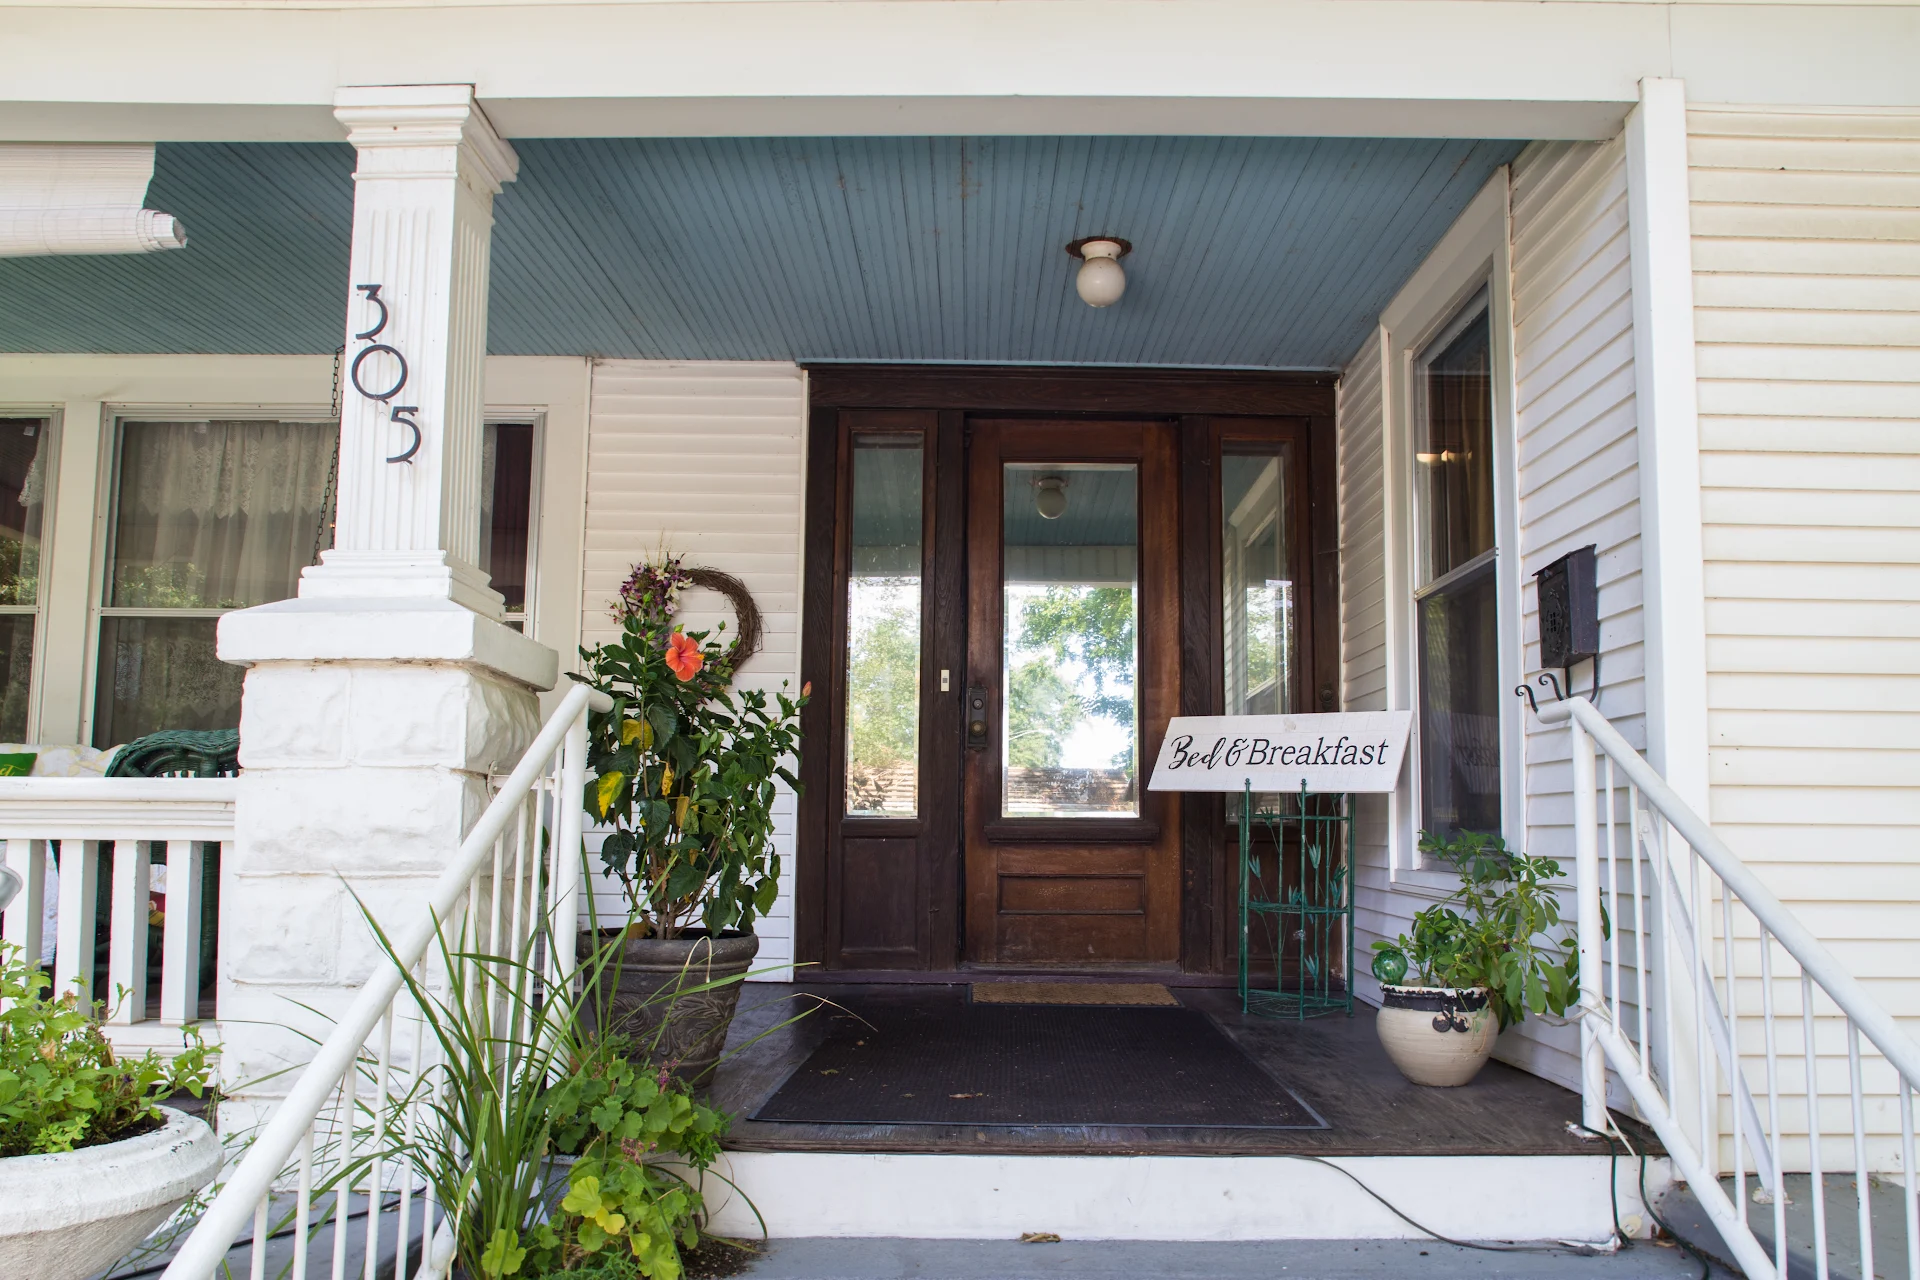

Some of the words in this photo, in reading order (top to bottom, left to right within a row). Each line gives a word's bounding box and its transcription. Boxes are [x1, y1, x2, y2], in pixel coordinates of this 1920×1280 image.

[351, 283, 422, 464] 305
[1168, 735, 1226, 770] Bed
[1246, 736, 1389, 766] Breakfast
